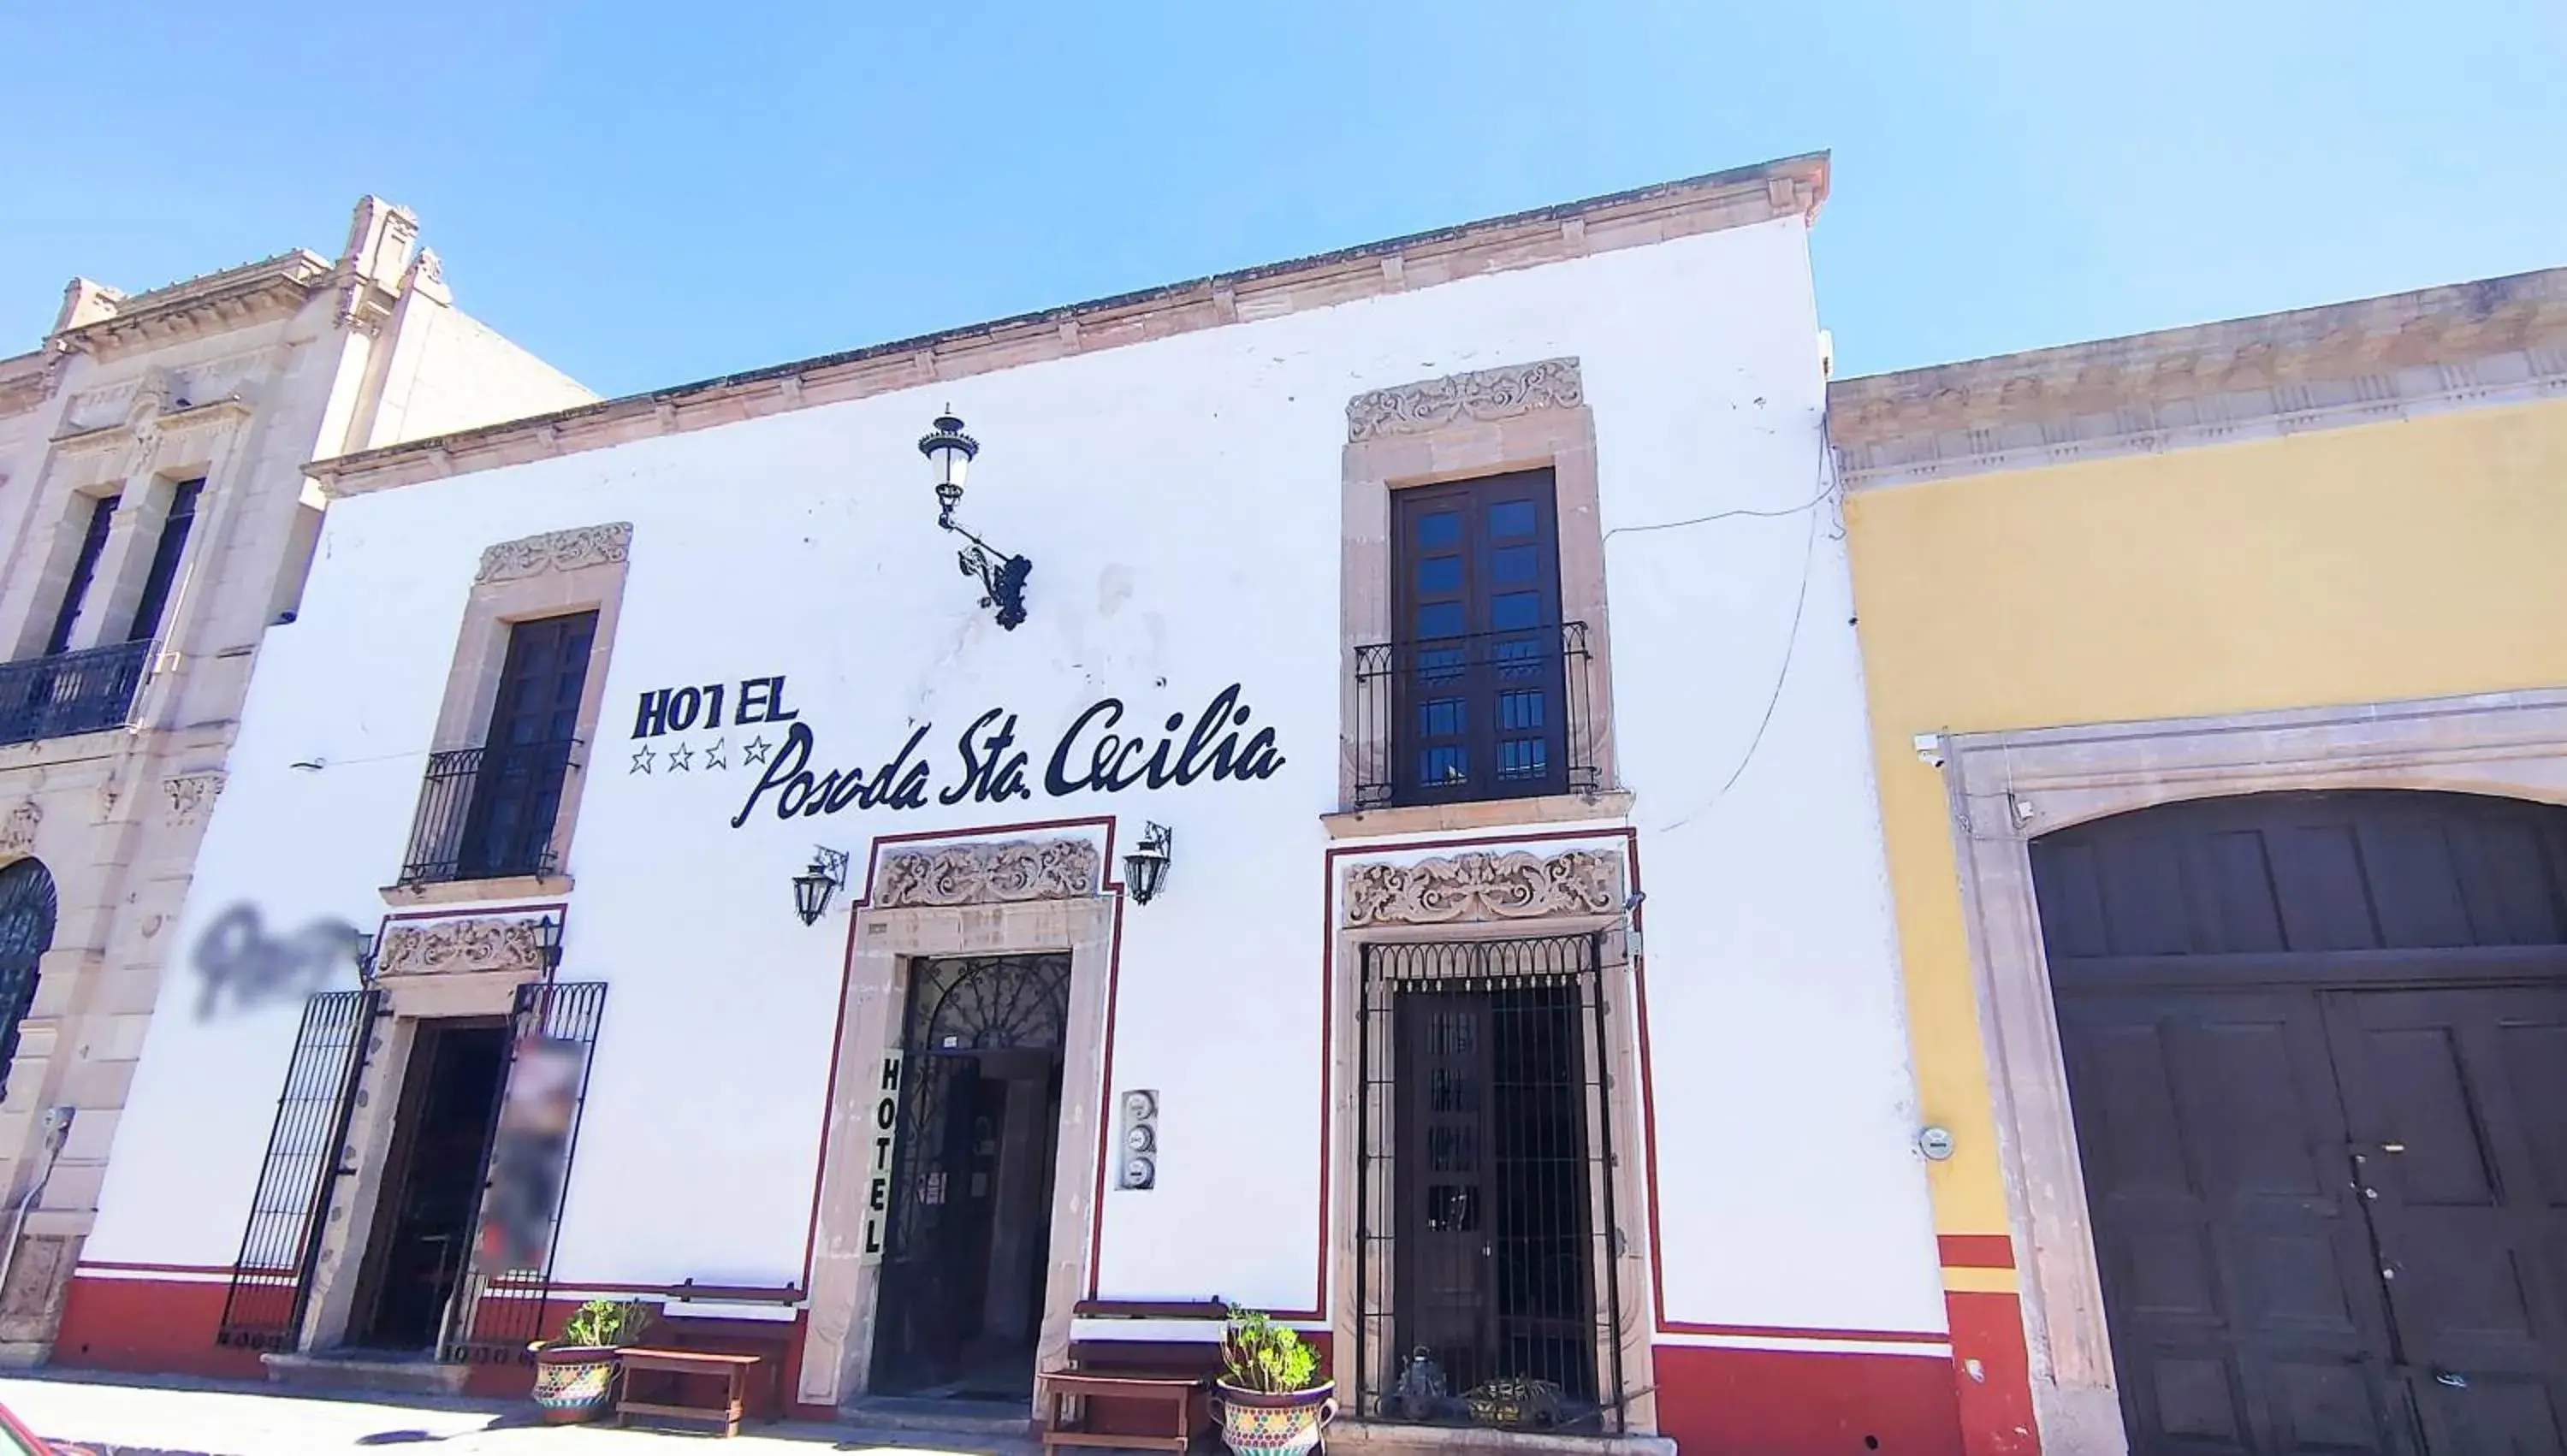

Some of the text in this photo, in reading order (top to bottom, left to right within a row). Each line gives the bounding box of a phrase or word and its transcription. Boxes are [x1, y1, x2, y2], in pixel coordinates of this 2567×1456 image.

[631, 675, 800, 740] HOTEL
[731, 683, 1286, 828] Posada Sta. Cecilia
[865, 1057, 900, 1254] HOTEL
